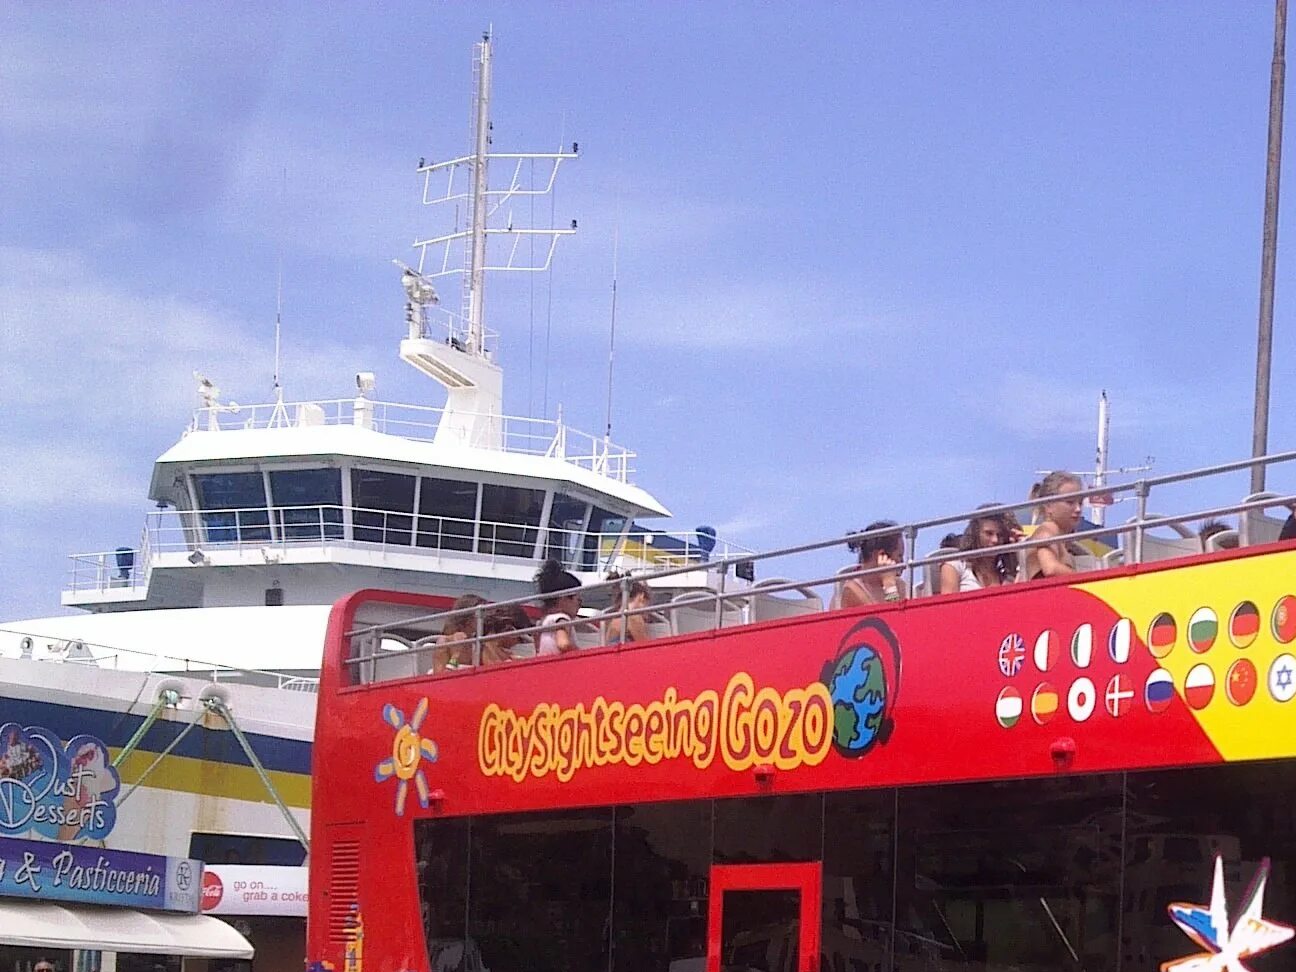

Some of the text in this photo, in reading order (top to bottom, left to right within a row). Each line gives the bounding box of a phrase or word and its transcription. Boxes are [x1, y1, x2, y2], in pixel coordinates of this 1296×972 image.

[720, 671, 835, 772] Gozo
[23, 734, 96, 803] Just
[0, 777, 109, 832] Desserts
[14, 851, 41, 892] &
[53, 850, 161, 897] Pasticceria
[243, 890, 268, 902] grab
[271, 892, 278, 901] a
